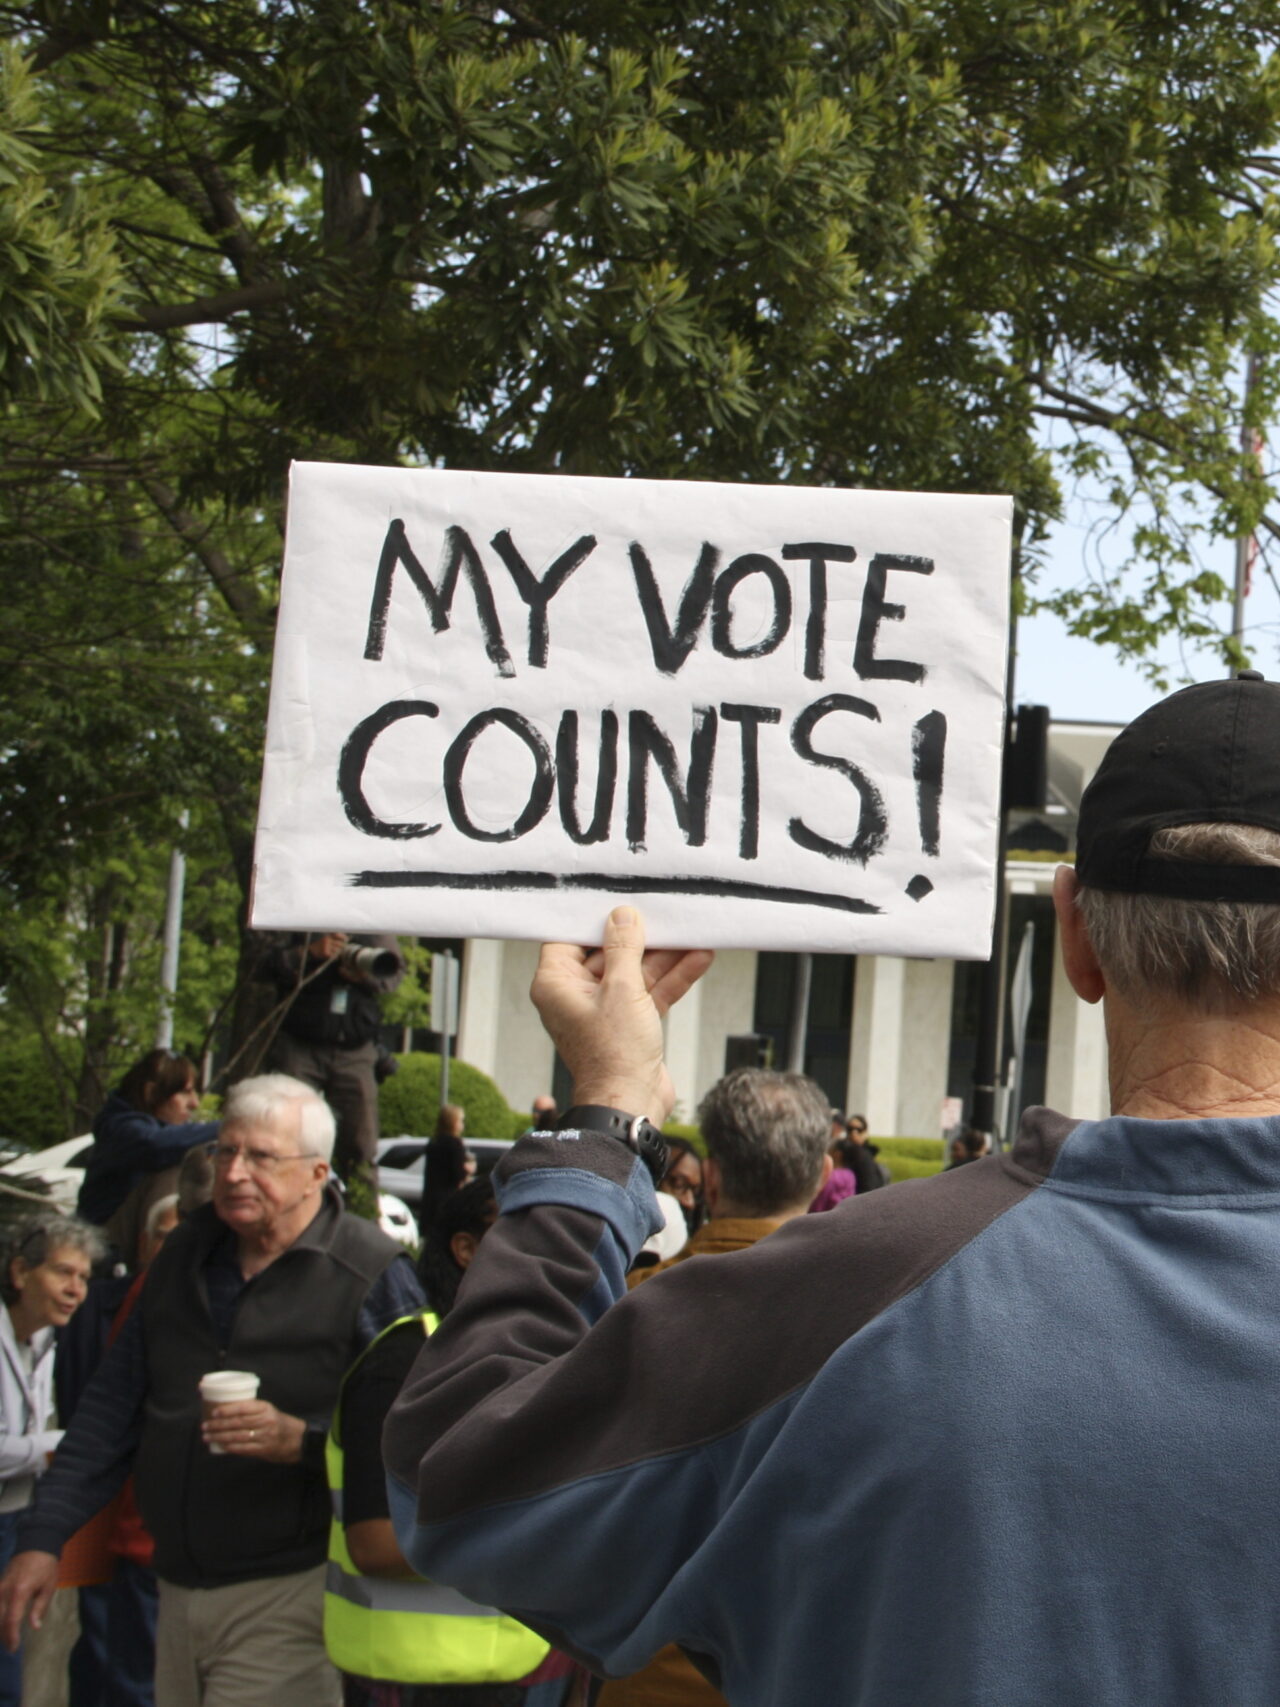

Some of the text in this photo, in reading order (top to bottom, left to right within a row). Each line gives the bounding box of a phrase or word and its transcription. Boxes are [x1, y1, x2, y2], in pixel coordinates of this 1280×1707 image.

[363, 517, 936, 683] MY VOTE
[336, 692, 948, 902] COUNTS!
